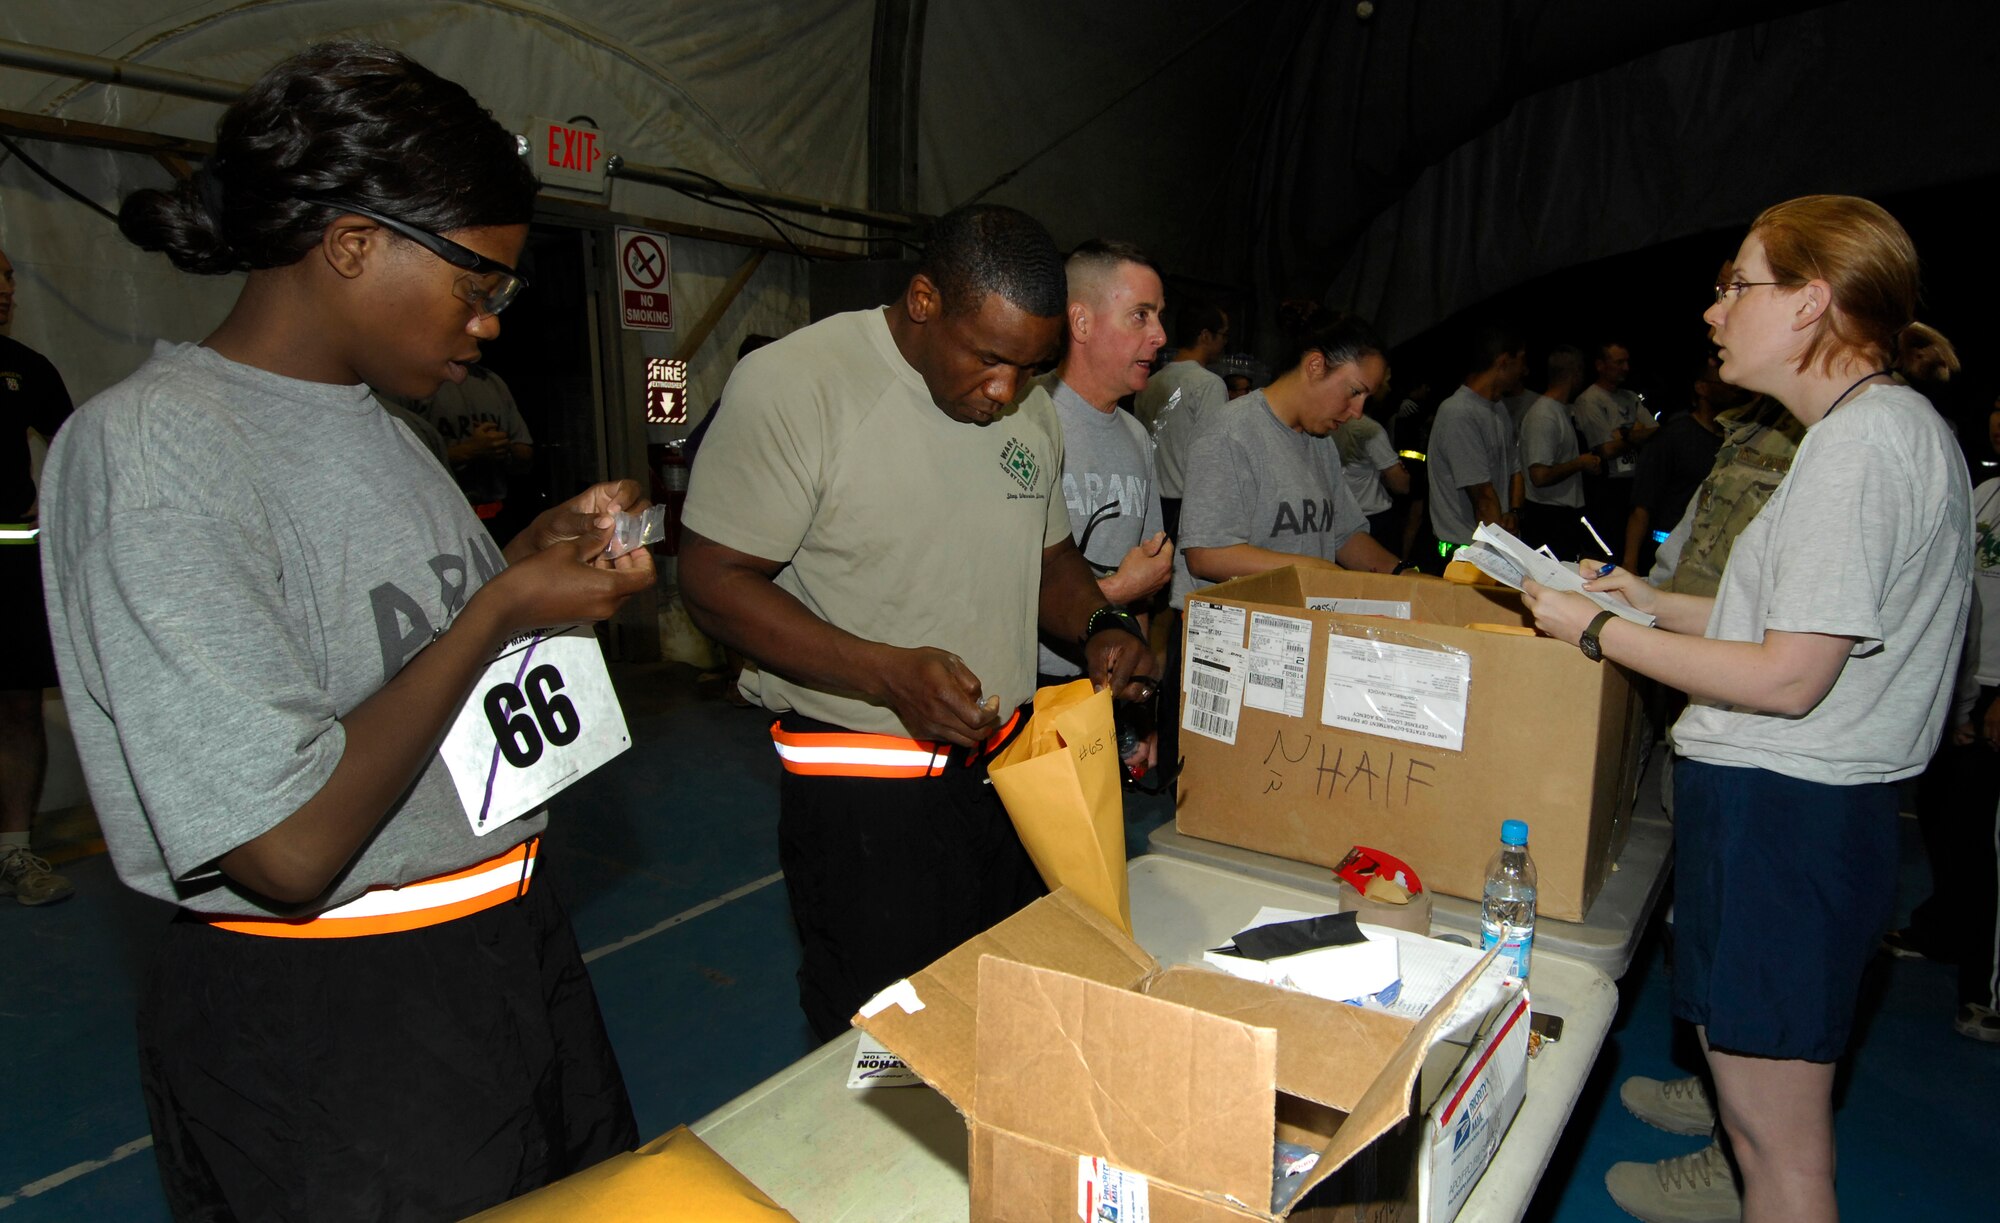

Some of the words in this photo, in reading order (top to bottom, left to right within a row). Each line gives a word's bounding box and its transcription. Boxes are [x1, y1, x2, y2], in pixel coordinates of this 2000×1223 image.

[547, 124, 597, 173] EXIT
[640, 293, 654, 308] NO
[626, 309, 669, 325] SMOKING
[652, 365, 682, 382] FIRE
[1270, 498, 1334, 538] ARM
[368, 532, 510, 683] ARM
[1296, 656, 1305, 666] 2
[482, 663, 581, 769] 66
[1336, 714, 1361, 725] DEFENSE
[1352, 711, 1375, 722] AGENCY
[1361, 719, 1369, 727] OF
[1403, 719, 1429, 730] DEFENSE
[1407, 727, 1427, 737] STATES
[1427, 731, 1447, 740] UNITED
[1468, 1081, 1488, 1113] PRIORITY
[1471, 1112, 1484, 1134] MAIL
